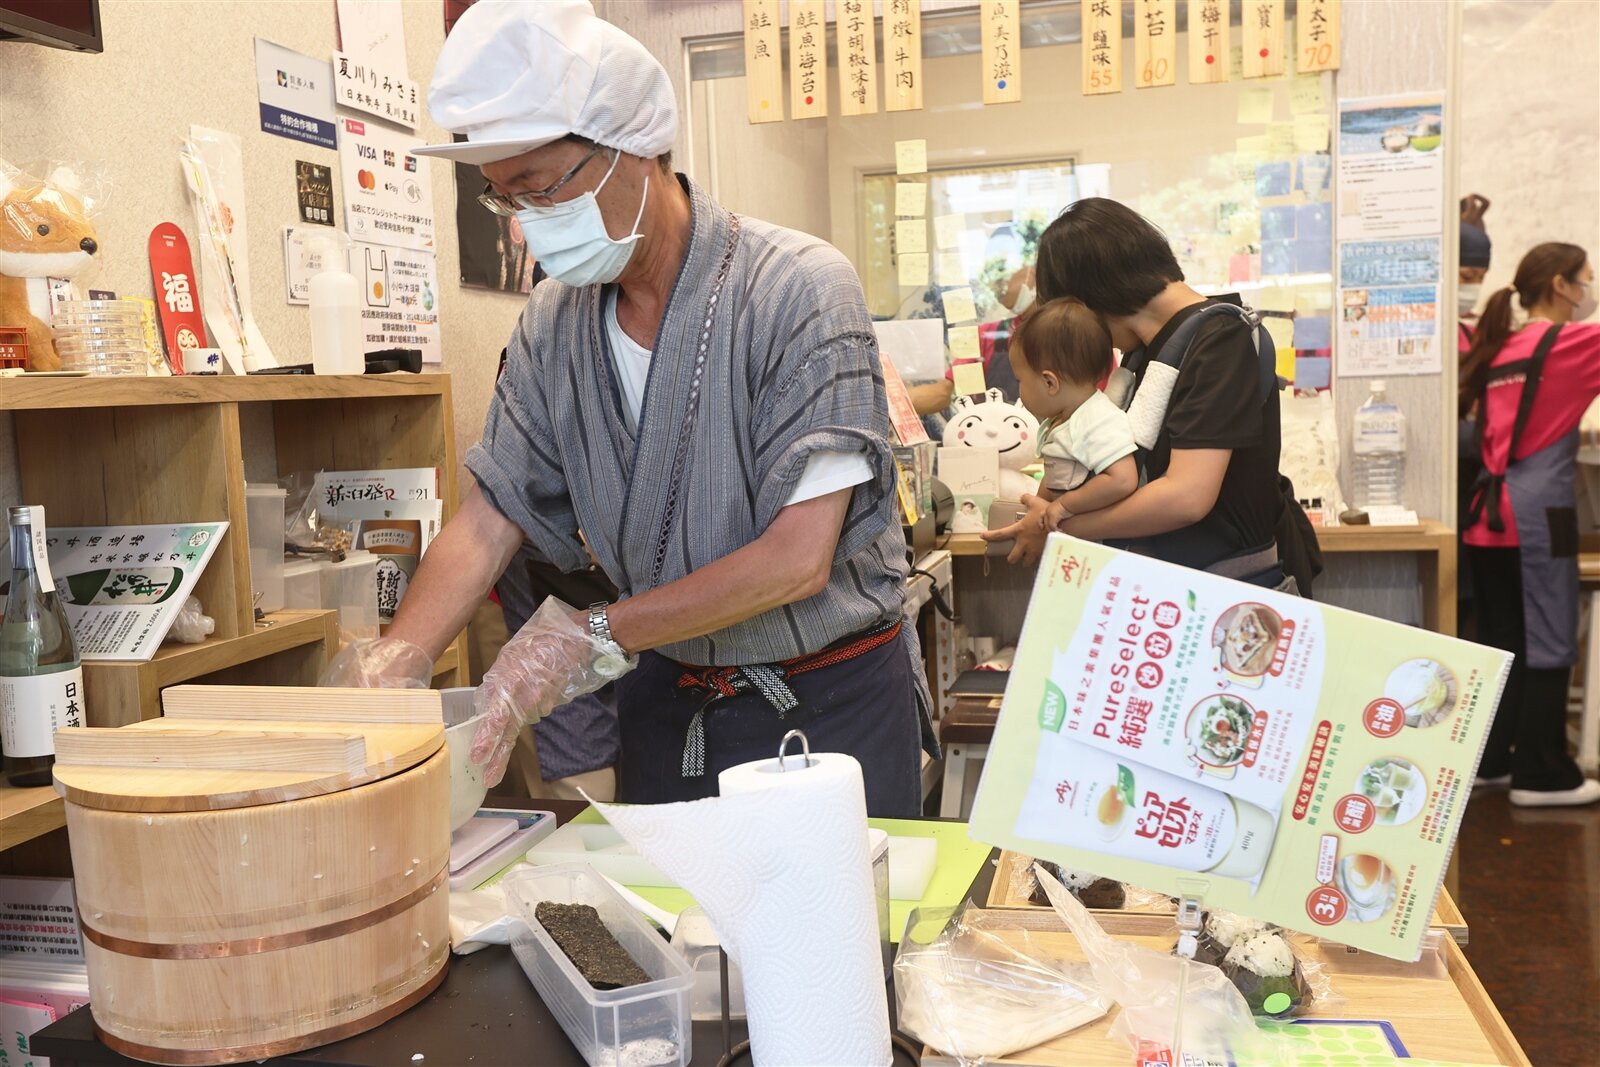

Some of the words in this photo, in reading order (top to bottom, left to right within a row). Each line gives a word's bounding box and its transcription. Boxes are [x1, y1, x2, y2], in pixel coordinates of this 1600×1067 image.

[749, 0, 772, 60] 鮭魚
[1144, 0, 1166, 37] 苔
[1200, 0, 1220, 48] 梅干
[1307, 0, 1329, 41] 太子
[1142, 57, 1168, 83] 60
[1304, 43, 1333, 69] 70
[339, 57, 416, 104] 夏川りみさま
[1090, 68, 1113, 88] 55
[356, 143, 378, 161] VISA
[161, 271, 195, 313] 福
[416, 488, 428, 500] 21
[381, 570, 401, 609] 新潟
[1039, 689, 1063, 727] NEW
[1133, 789, 1168, 840] ピュア
[1157, 793, 1193, 851] セレクト
[1184, 809, 1203, 846] マヨネーズ
[1239, 828, 1255, 852] 400g
